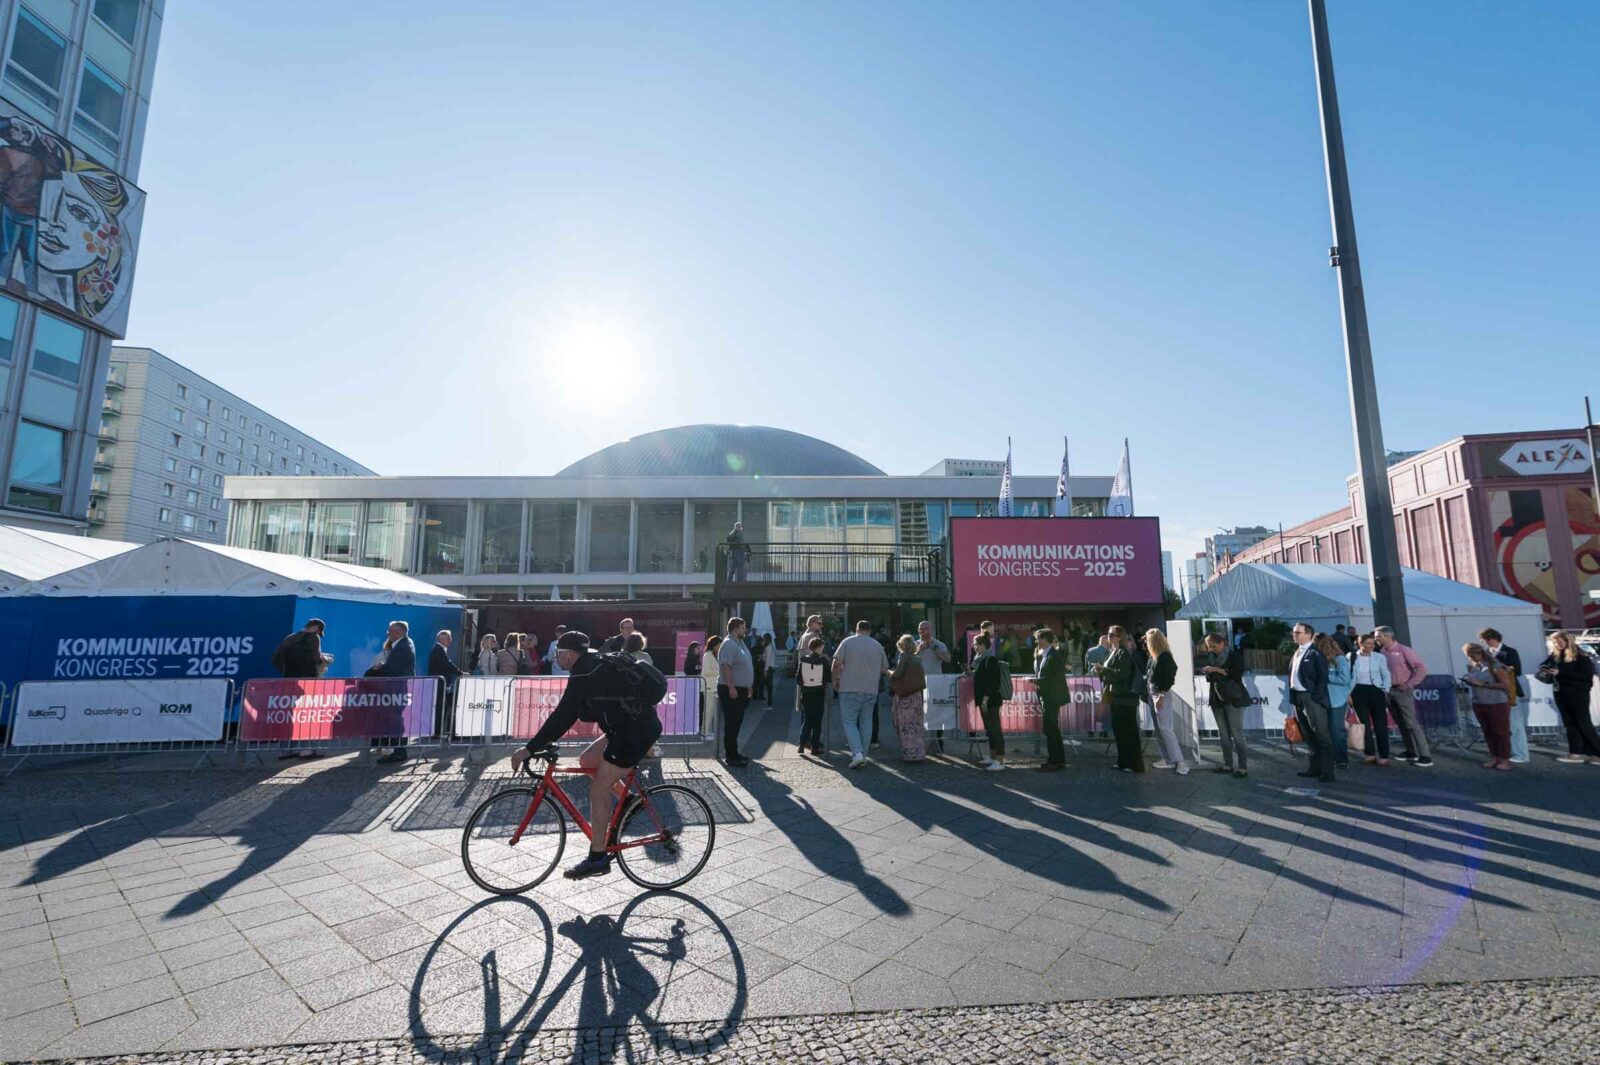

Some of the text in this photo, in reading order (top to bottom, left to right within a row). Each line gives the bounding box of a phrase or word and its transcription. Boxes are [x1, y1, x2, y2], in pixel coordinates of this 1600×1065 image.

[1516, 443, 1585, 471] ALEXA
[977, 544, 1135, 560] KOMMUNIKATIONS
[978, 561, 1060, 577] KONGRESS
[1084, 561, 1126, 577] 2025
[57, 636, 254, 656] KOMMUNIKATIONS
[54, 657, 158, 677] KONGRESS
[186, 657, 239, 676] 2025
[159, 703, 192, 714] KOM
[267, 692, 412, 709] KOMMUNIKATIONS
[468, 702, 495, 710] BdKom
[84, 706, 129, 717] Quadriga
[266, 708, 343, 724] KONGRESS
